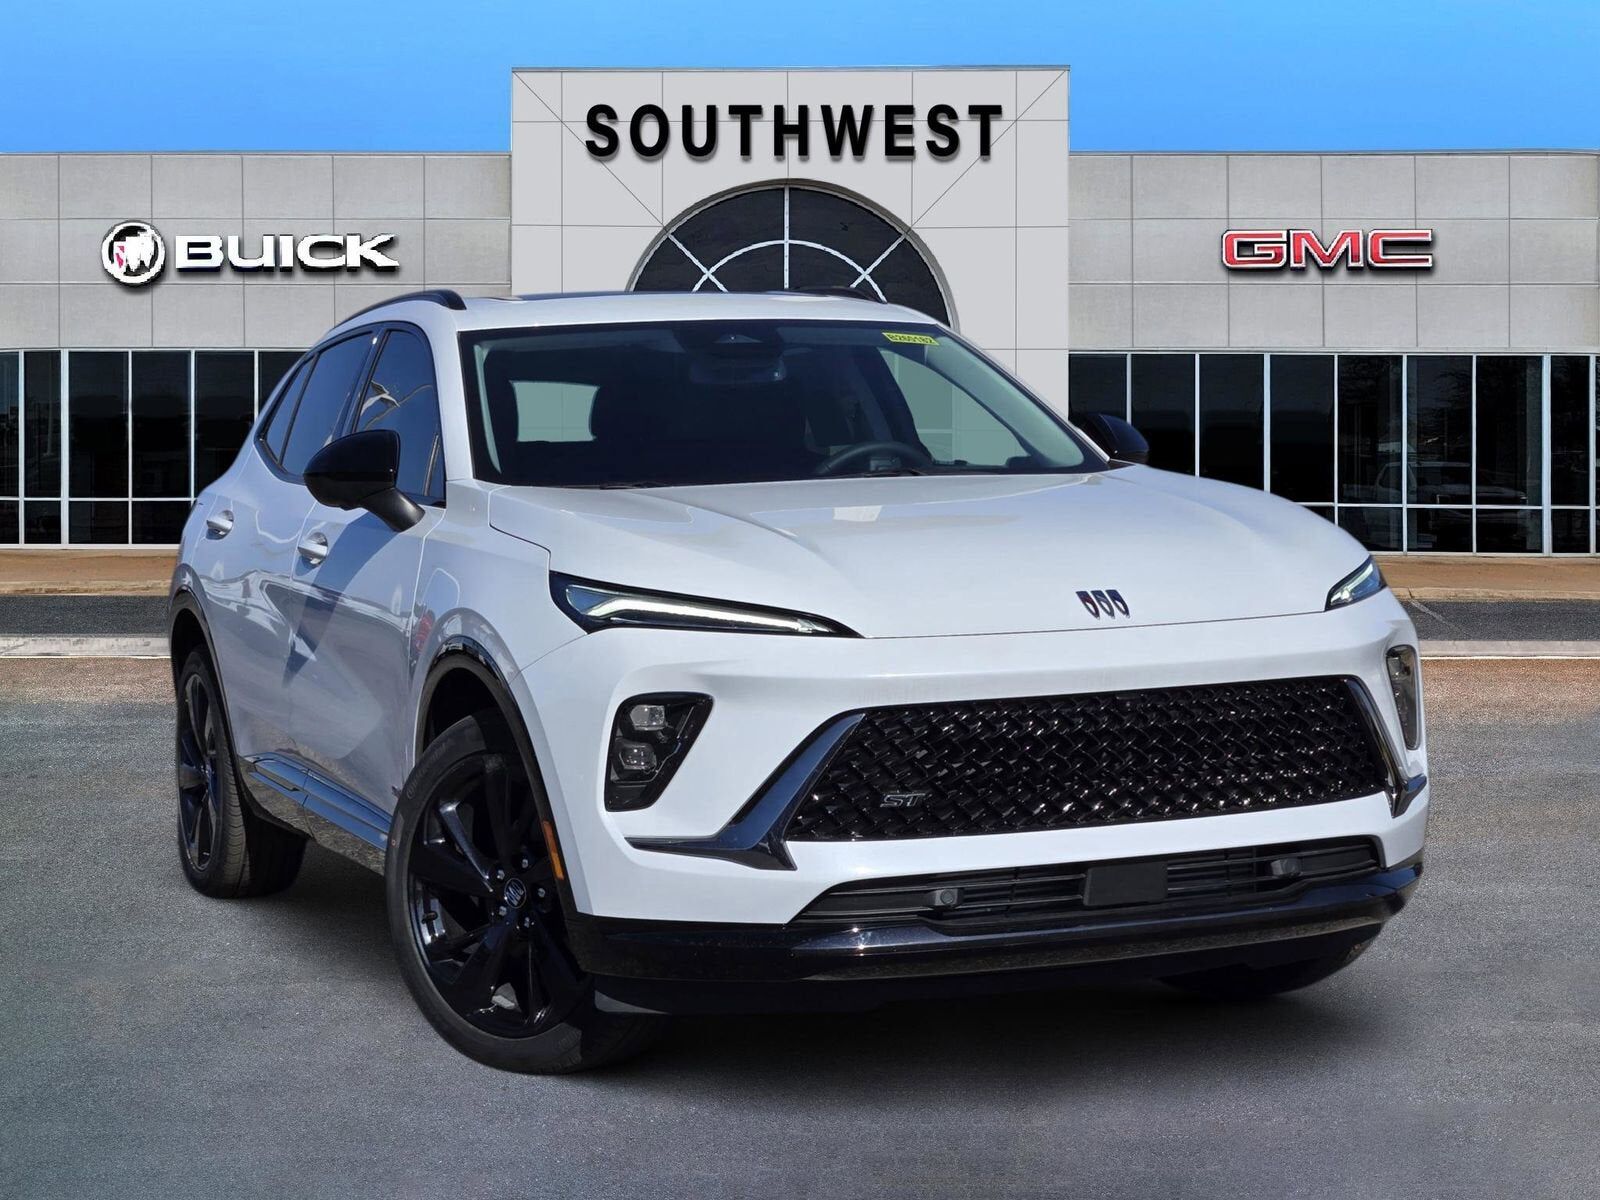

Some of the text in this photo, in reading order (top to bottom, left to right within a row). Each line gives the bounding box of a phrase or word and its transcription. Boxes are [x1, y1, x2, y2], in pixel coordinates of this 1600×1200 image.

[585, 103, 1004, 158] SOUTHWEST
[174, 233, 400, 270] BUICK
[1221, 229, 1434, 269] GMC
[880, 793, 926, 807] ST
